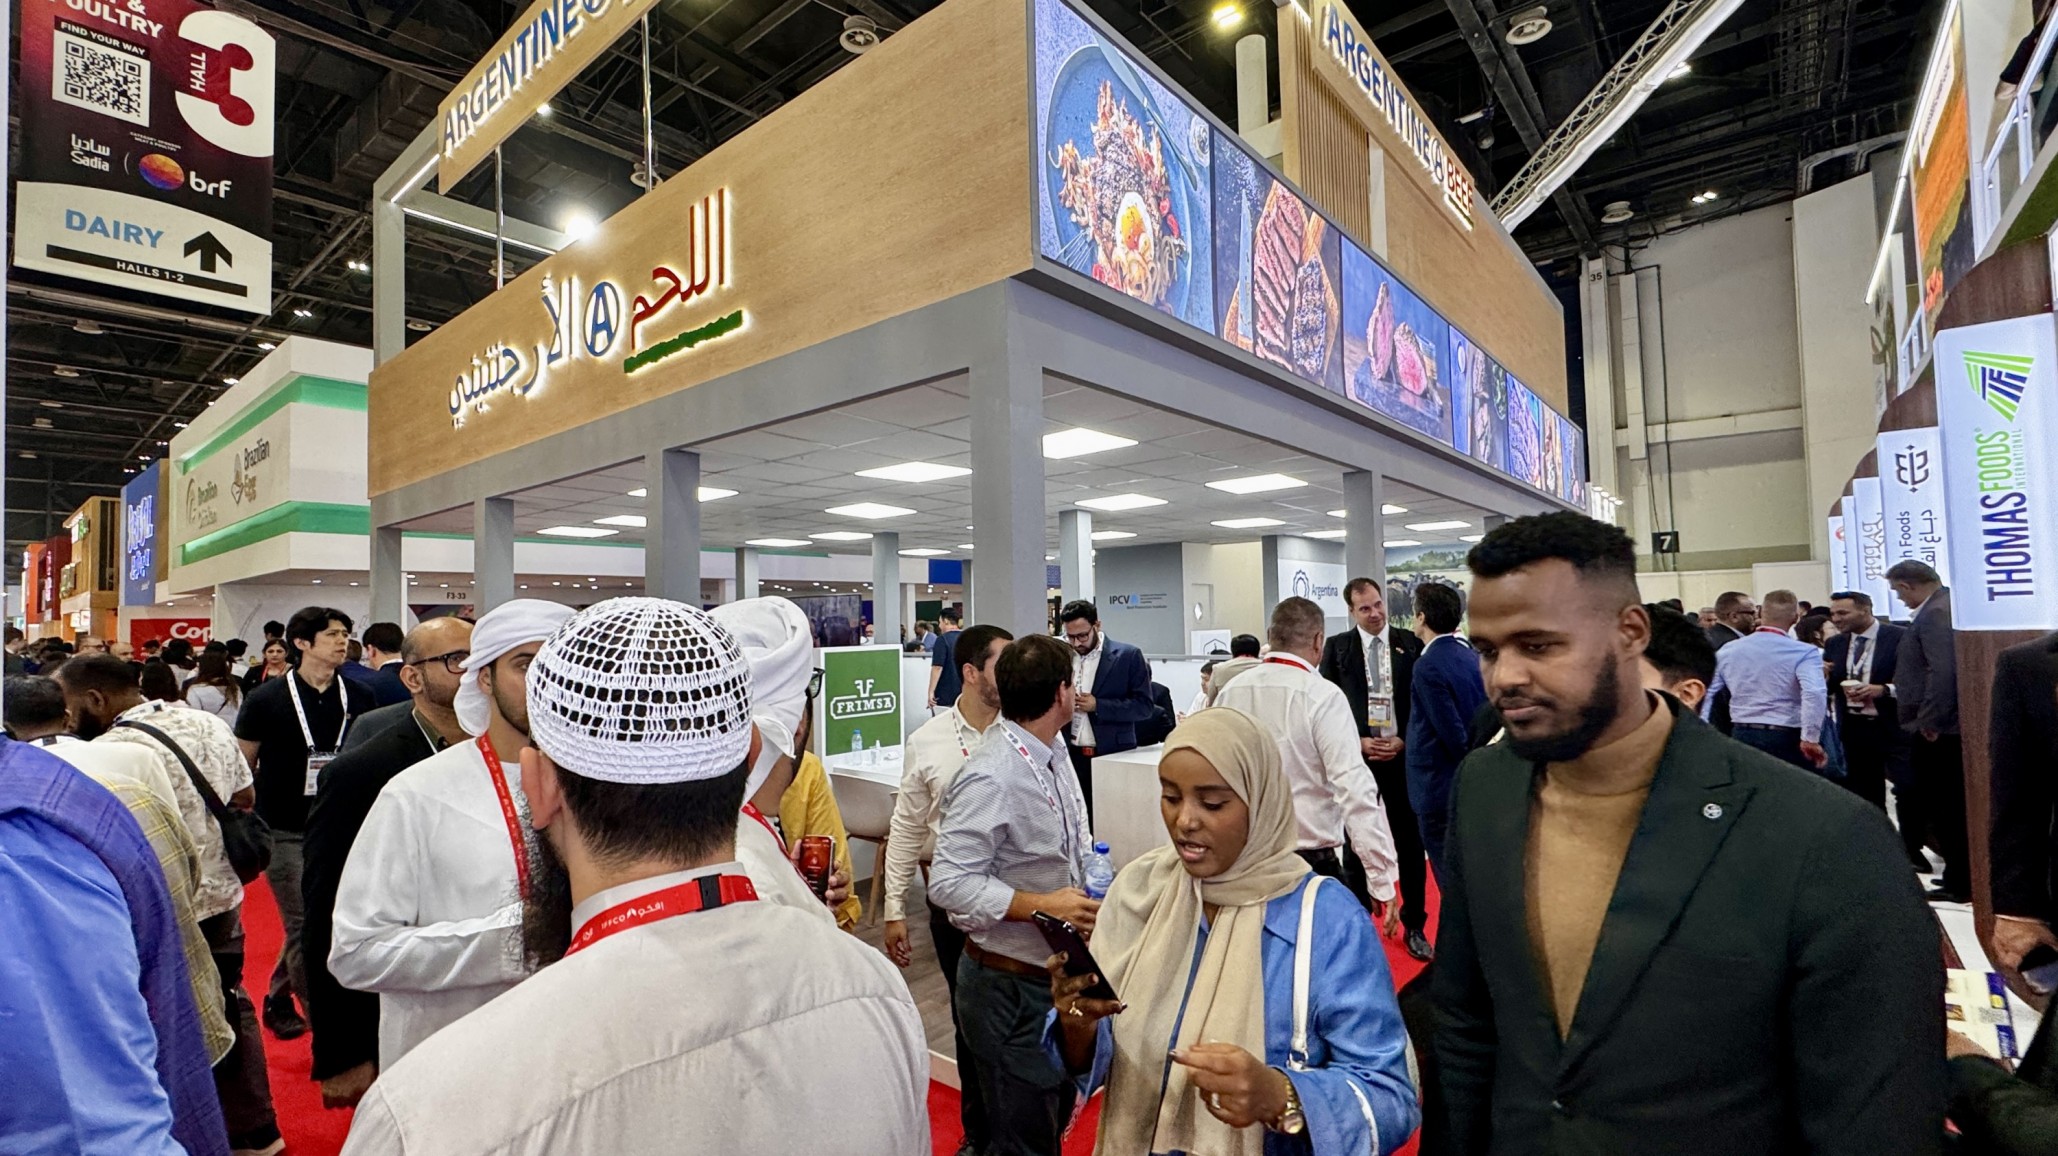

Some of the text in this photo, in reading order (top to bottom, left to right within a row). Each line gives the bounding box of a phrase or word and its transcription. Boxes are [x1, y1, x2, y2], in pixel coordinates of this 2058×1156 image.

[64, 0, 163, 38] OULTRY
[60, 21, 146, 56] FIND YOUR WAY
[174, 9, 276, 158] 3
[190, 52, 206, 93] HALL
[443, 0, 582, 157] ARGENTINE
[1325, 3, 1430, 170] ARGENTINE
[1444, 154, 1474, 214] BEEF
[70, 150, 110, 173] Sadia
[189, 170, 233, 199] brf
[65, 208, 164, 249] DAIRY
[115, 260, 185, 284] HALLS 1-2
[630, 186, 726, 351] اللحم
[1589, 271, 1603, 282] 35
[449, 273, 577, 429] الأرجنتيني
[244, 437, 270, 471] Brazilian
[2011, 428, 2027, 490] INTERNATIONAL
[1896, 510, 1914, 547] Foods
[1974, 430, 2034, 602] THOMAS FOODS
[1660, 535, 1672, 550] 7
[446, 591, 466, 600] F3-33
[1109, 594, 1130, 605] IPCV
[1311, 583, 1339, 600] Argentina
[836, 697, 893, 714] FRIMSA
[601, 914, 626, 930] IFFCO
